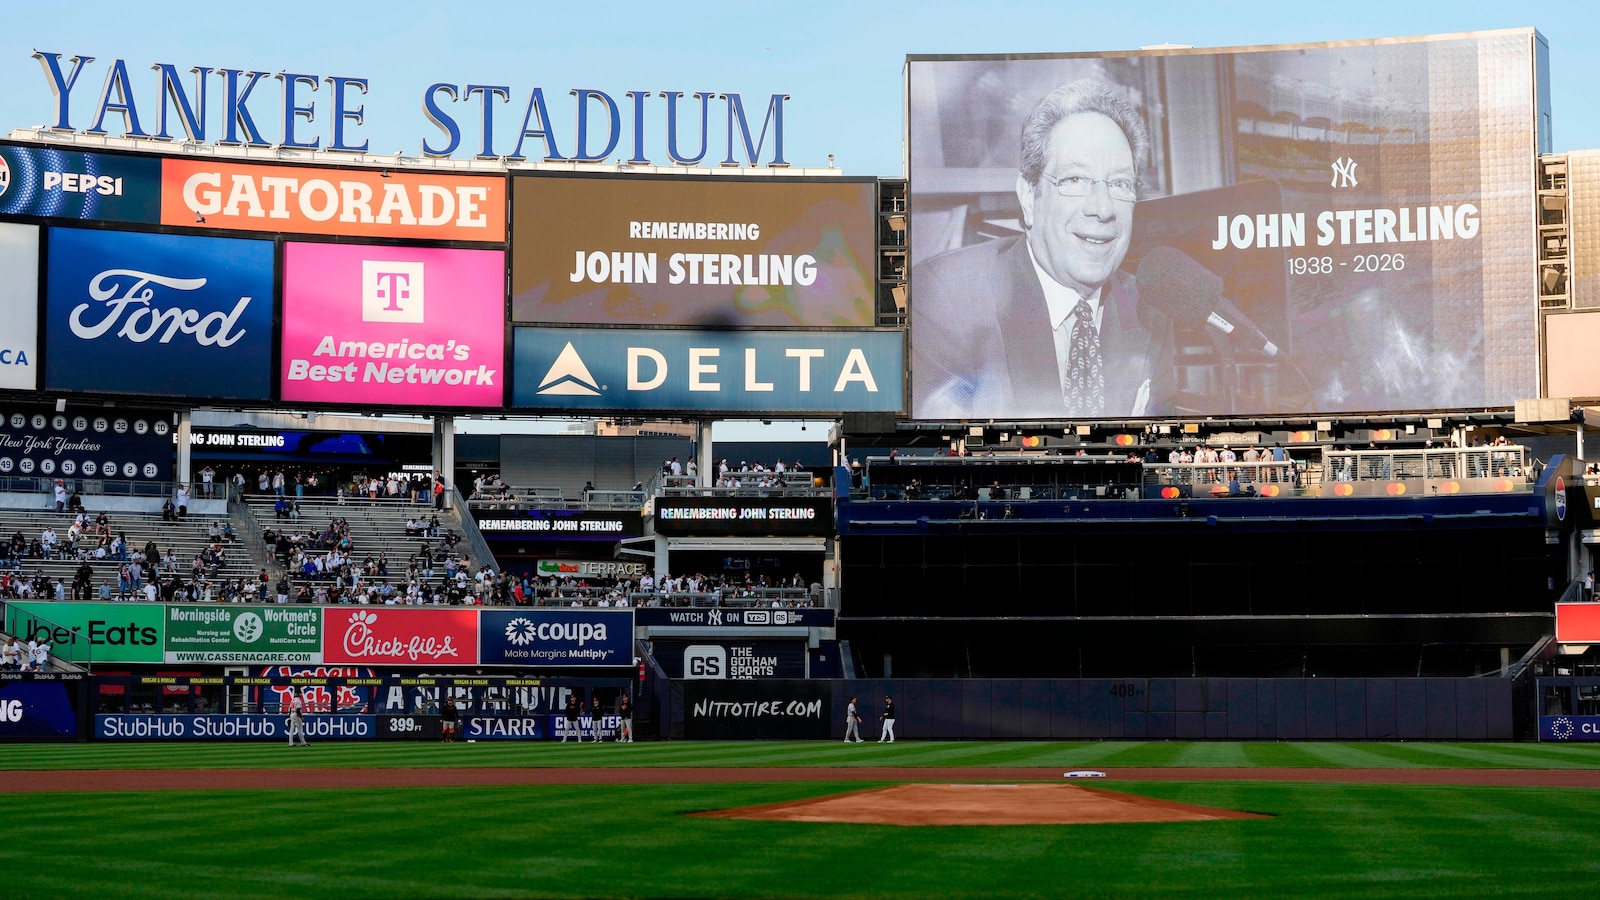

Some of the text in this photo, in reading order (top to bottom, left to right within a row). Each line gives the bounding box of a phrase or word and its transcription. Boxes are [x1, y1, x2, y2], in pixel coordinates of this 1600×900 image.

[32, 49, 791, 168] YANKEE STADIUM
[44, 171, 123, 196] PEPSI
[182, 172, 488, 228] GATORADE
[630, 221, 760, 241] REMEMBERING
[1212, 203, 1480, 250] JOHN STERLING
[570, 251, 818, 286] JOHN STERLING
[1288, 256, 1333, 275] 1938
[1353, 253, 1405, 273] 2026
[69, 268, 252, 348] Ford
[287, 359, 496, 386] Best Network
[626, 347, 879, 393] DELTA
[0, 434, 101, 455] New York Yankees
[206, 434, 235, 445] JOHN
[237, 435, 285, 446] STERLING
[661, 508, 815, 519] REMEMBERING JOHN STERLING
[479, 520, 623, 531] REMEMBERING JOHN STERLING
[581, 561, 642, 575] TERRACE
[170, 608, 230, 624] Morningside
[264, 609, 317, 622] Workmen's
[670, 612, 704, 622] WATCH
[727, 612, 739, 622] ON
[88, 620, 157, 646] Eats
[287, 622, 316, 635] Circle
[537, 622, 607, 646] coupa
[343, 620, 459, 661] Chick-fil-A
[176, 653, 311, 662] WWW.CASSENACARE.COM
[504, 649, 529, 658] Make
[530, 650, 567, 660] Margins
[731, 647, 753, 656] THE
[731, 657, 777, 666] GOTHAM
[690, 656, 720, 676] GS
[731, 666, 774, 676] SPORTS
[1110, 684, 1135, 697] 408
[694, 698, 821, 719] NITTOTIRE.COM
[103, 717, 185, 737] StubHub
[192, 717, 275, 736] StubHub
[390, 717, 415, 732] 399
[470, 717, 536, 736] STARR
